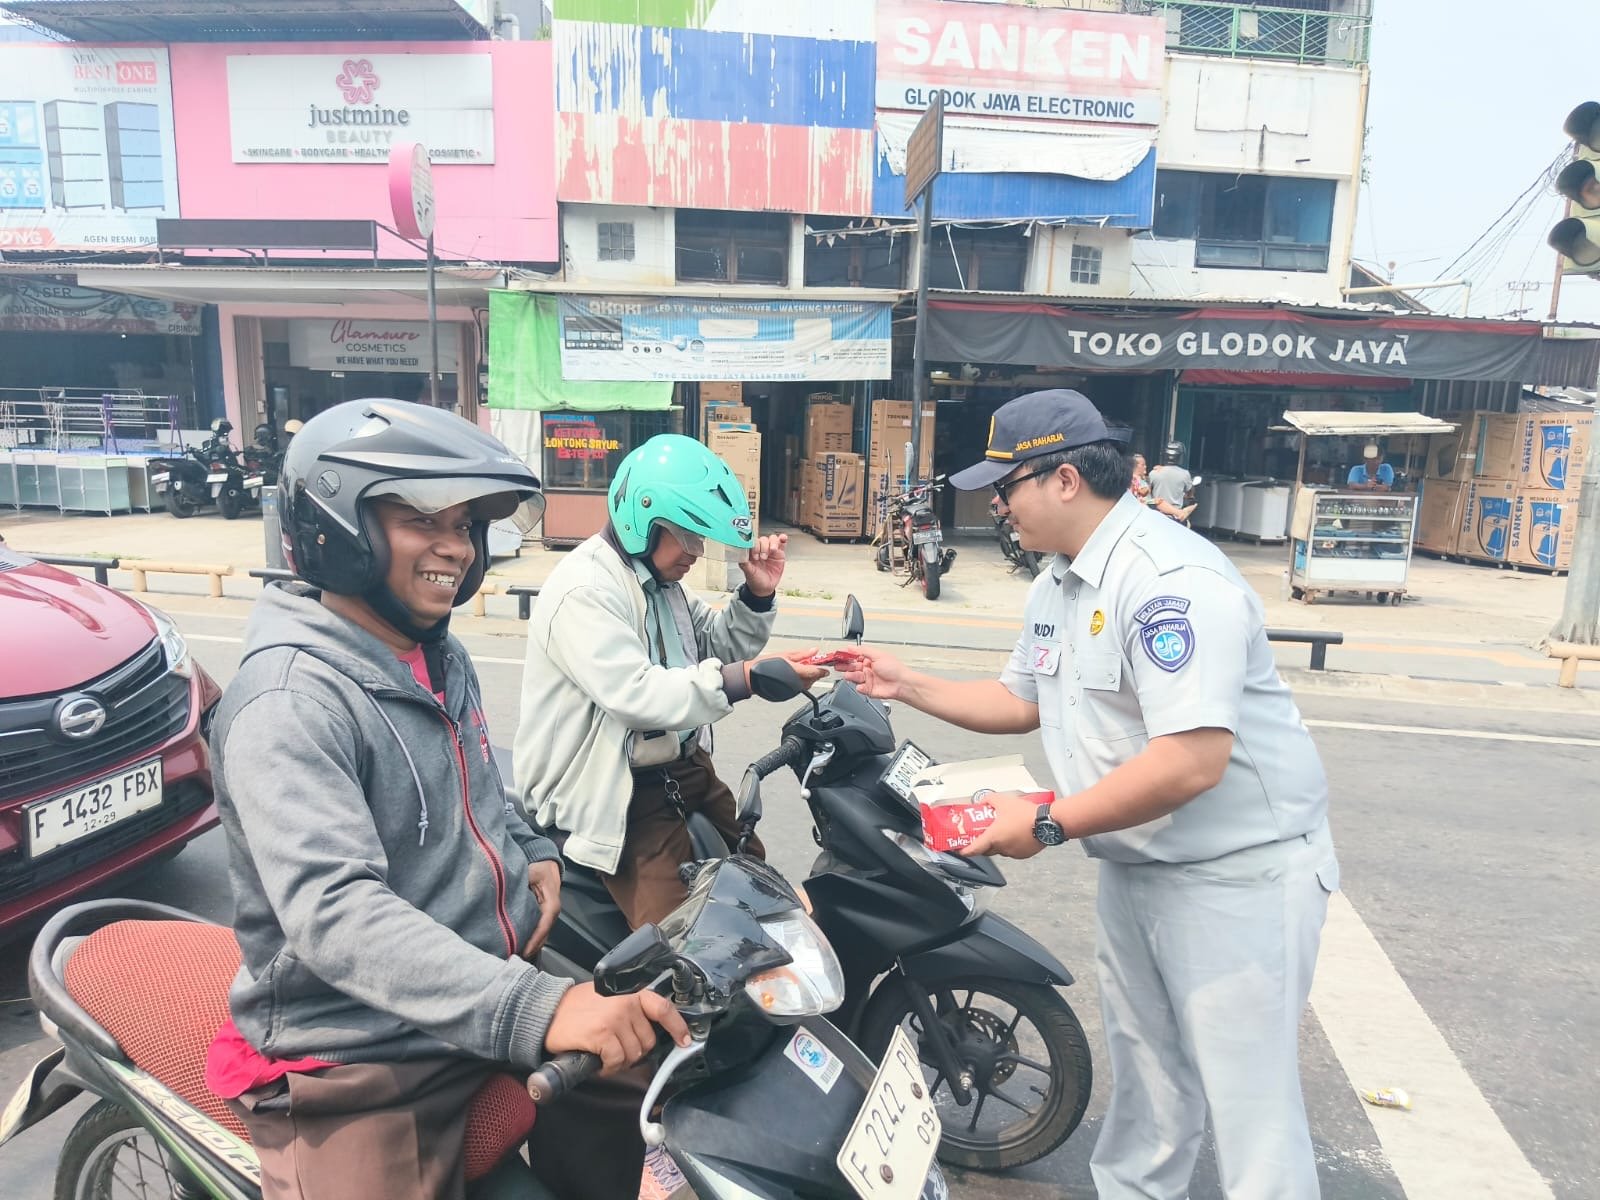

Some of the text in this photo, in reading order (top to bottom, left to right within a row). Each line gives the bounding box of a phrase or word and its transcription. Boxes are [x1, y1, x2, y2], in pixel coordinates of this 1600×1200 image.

[893, 17, 1149, 80] SANKEN
[73, 54, 98, 64] NEW
[74, 65, 155, 81] BEST ONE
[905, 88, 1135, 119] GLODOK JAYA ELECTRONIC
[308, 104, 410, 127] justmine
[326, 130, 393, 144] BEAUTY
[248, 148, 475, 158] SKINCARE BODYCARE HEALTH COSMETIC
[84, 235, 108, 243] AGEN
[111, 235, 136, 243] RESMI
[655, 304, 671, 312] LED
[673, 304, 684, 313] TV
[693, 304, 708, 313] AIR
[710, 304, 771, 313] CONDITIONER
[779, 304, 822, 313] WASHING
[823, 304, 864, 313] MACHINE
[345, 343, 407, 353] COSMETICS
[1068, 330, 1408, 365] TOKO GLODOK JAYA
[336, 356, 347, 364] WE
[347, 356, 365, 365] HAVE
[366, 357, 384, 365] WHAT
[386, 357, 399, 366] YOU
[544, 437, 619, 449] LONTONG SAYUR
[1015, 433, 1065, 451] JASA RAHARJA
[1521, 419, 1535, 473] SANKEN
[1511, 495, 1524, 547] SANKEN
[1158, 623, 1186, 632] RAHARJA
[34, 765, 159, 838] F 1432 FBX
[850, 1151, 874, 1190] F
[865, 1081, 906, 1157] 2242
